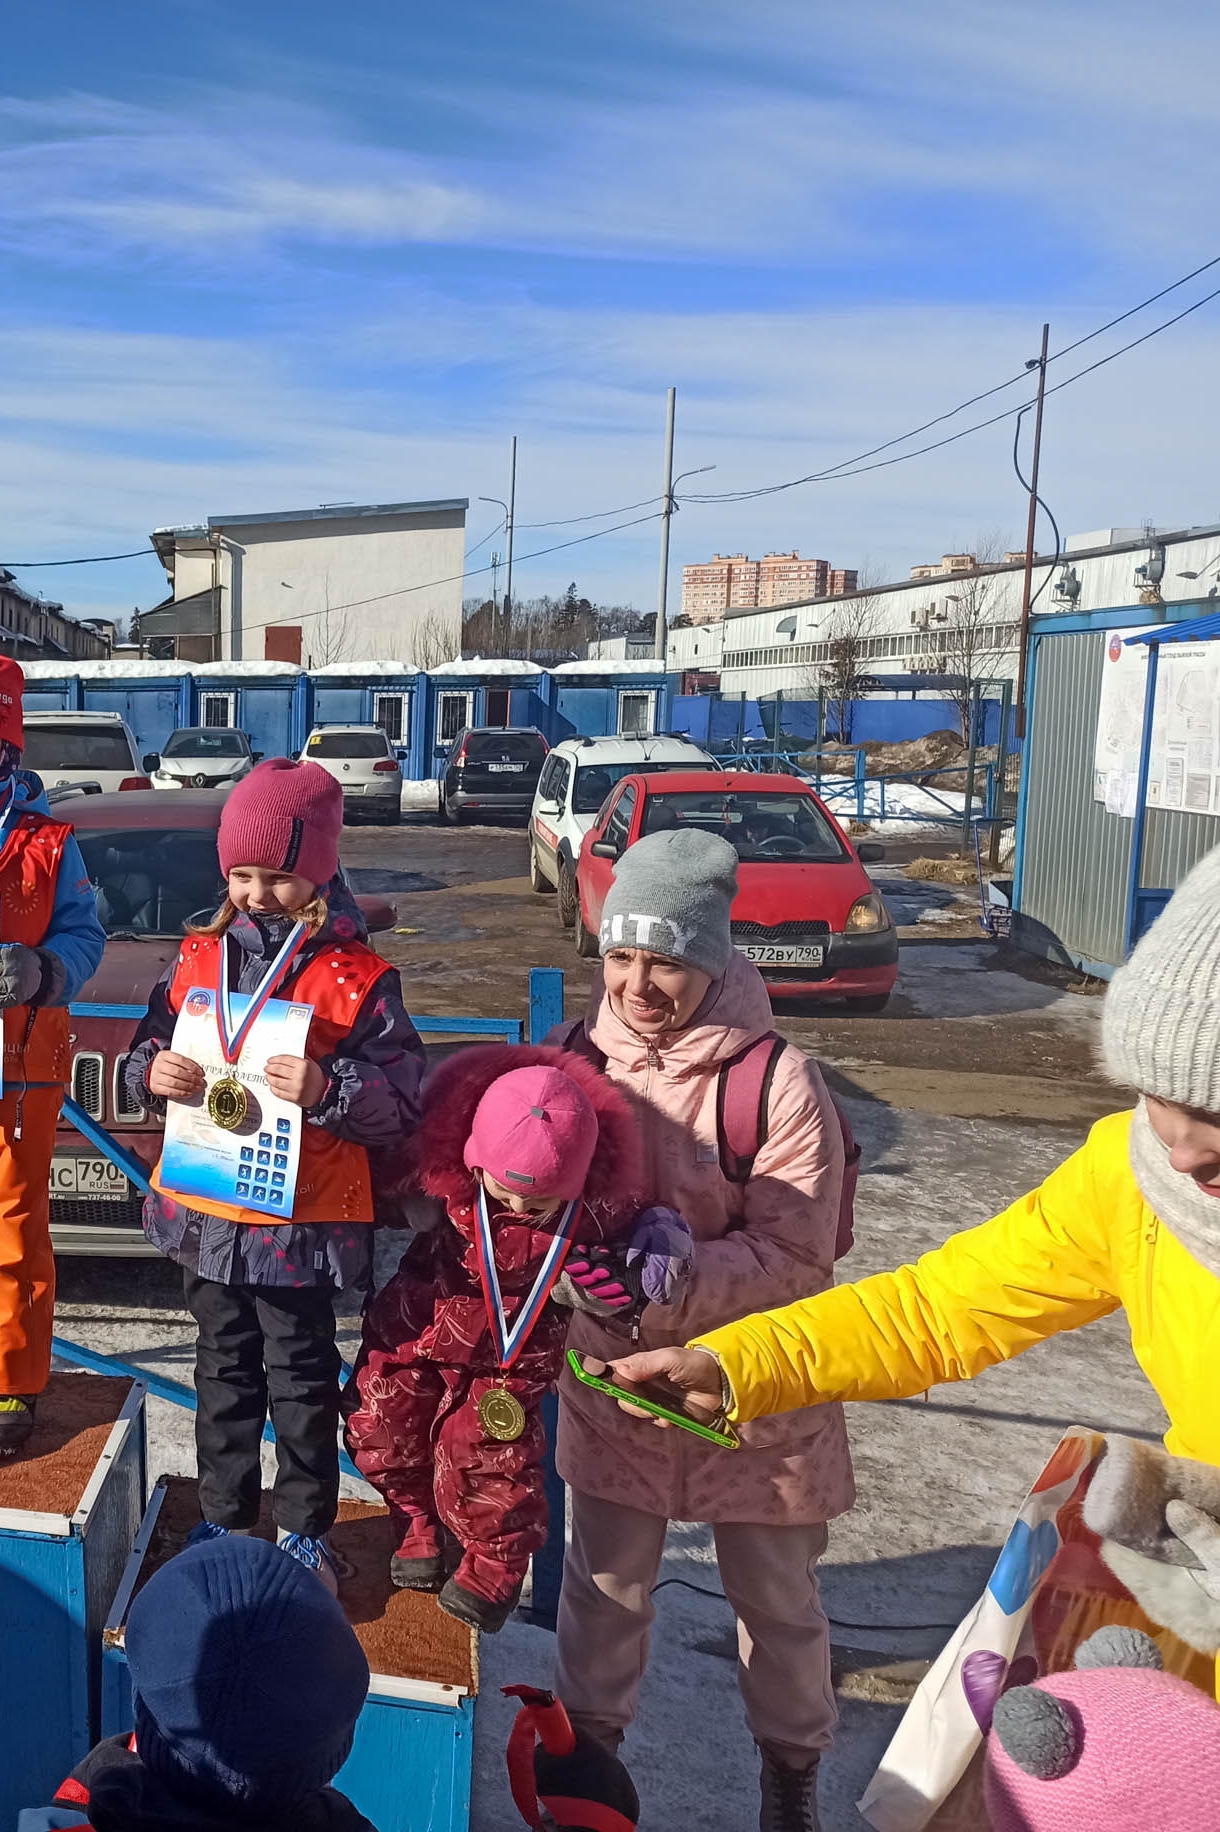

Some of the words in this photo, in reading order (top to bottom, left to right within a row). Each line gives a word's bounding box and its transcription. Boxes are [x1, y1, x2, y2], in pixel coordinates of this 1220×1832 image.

[798, 946, 817, 958] 790
[78, 1161, 119, 1180] 790
[89, 1181, 109, 1189] RUS
